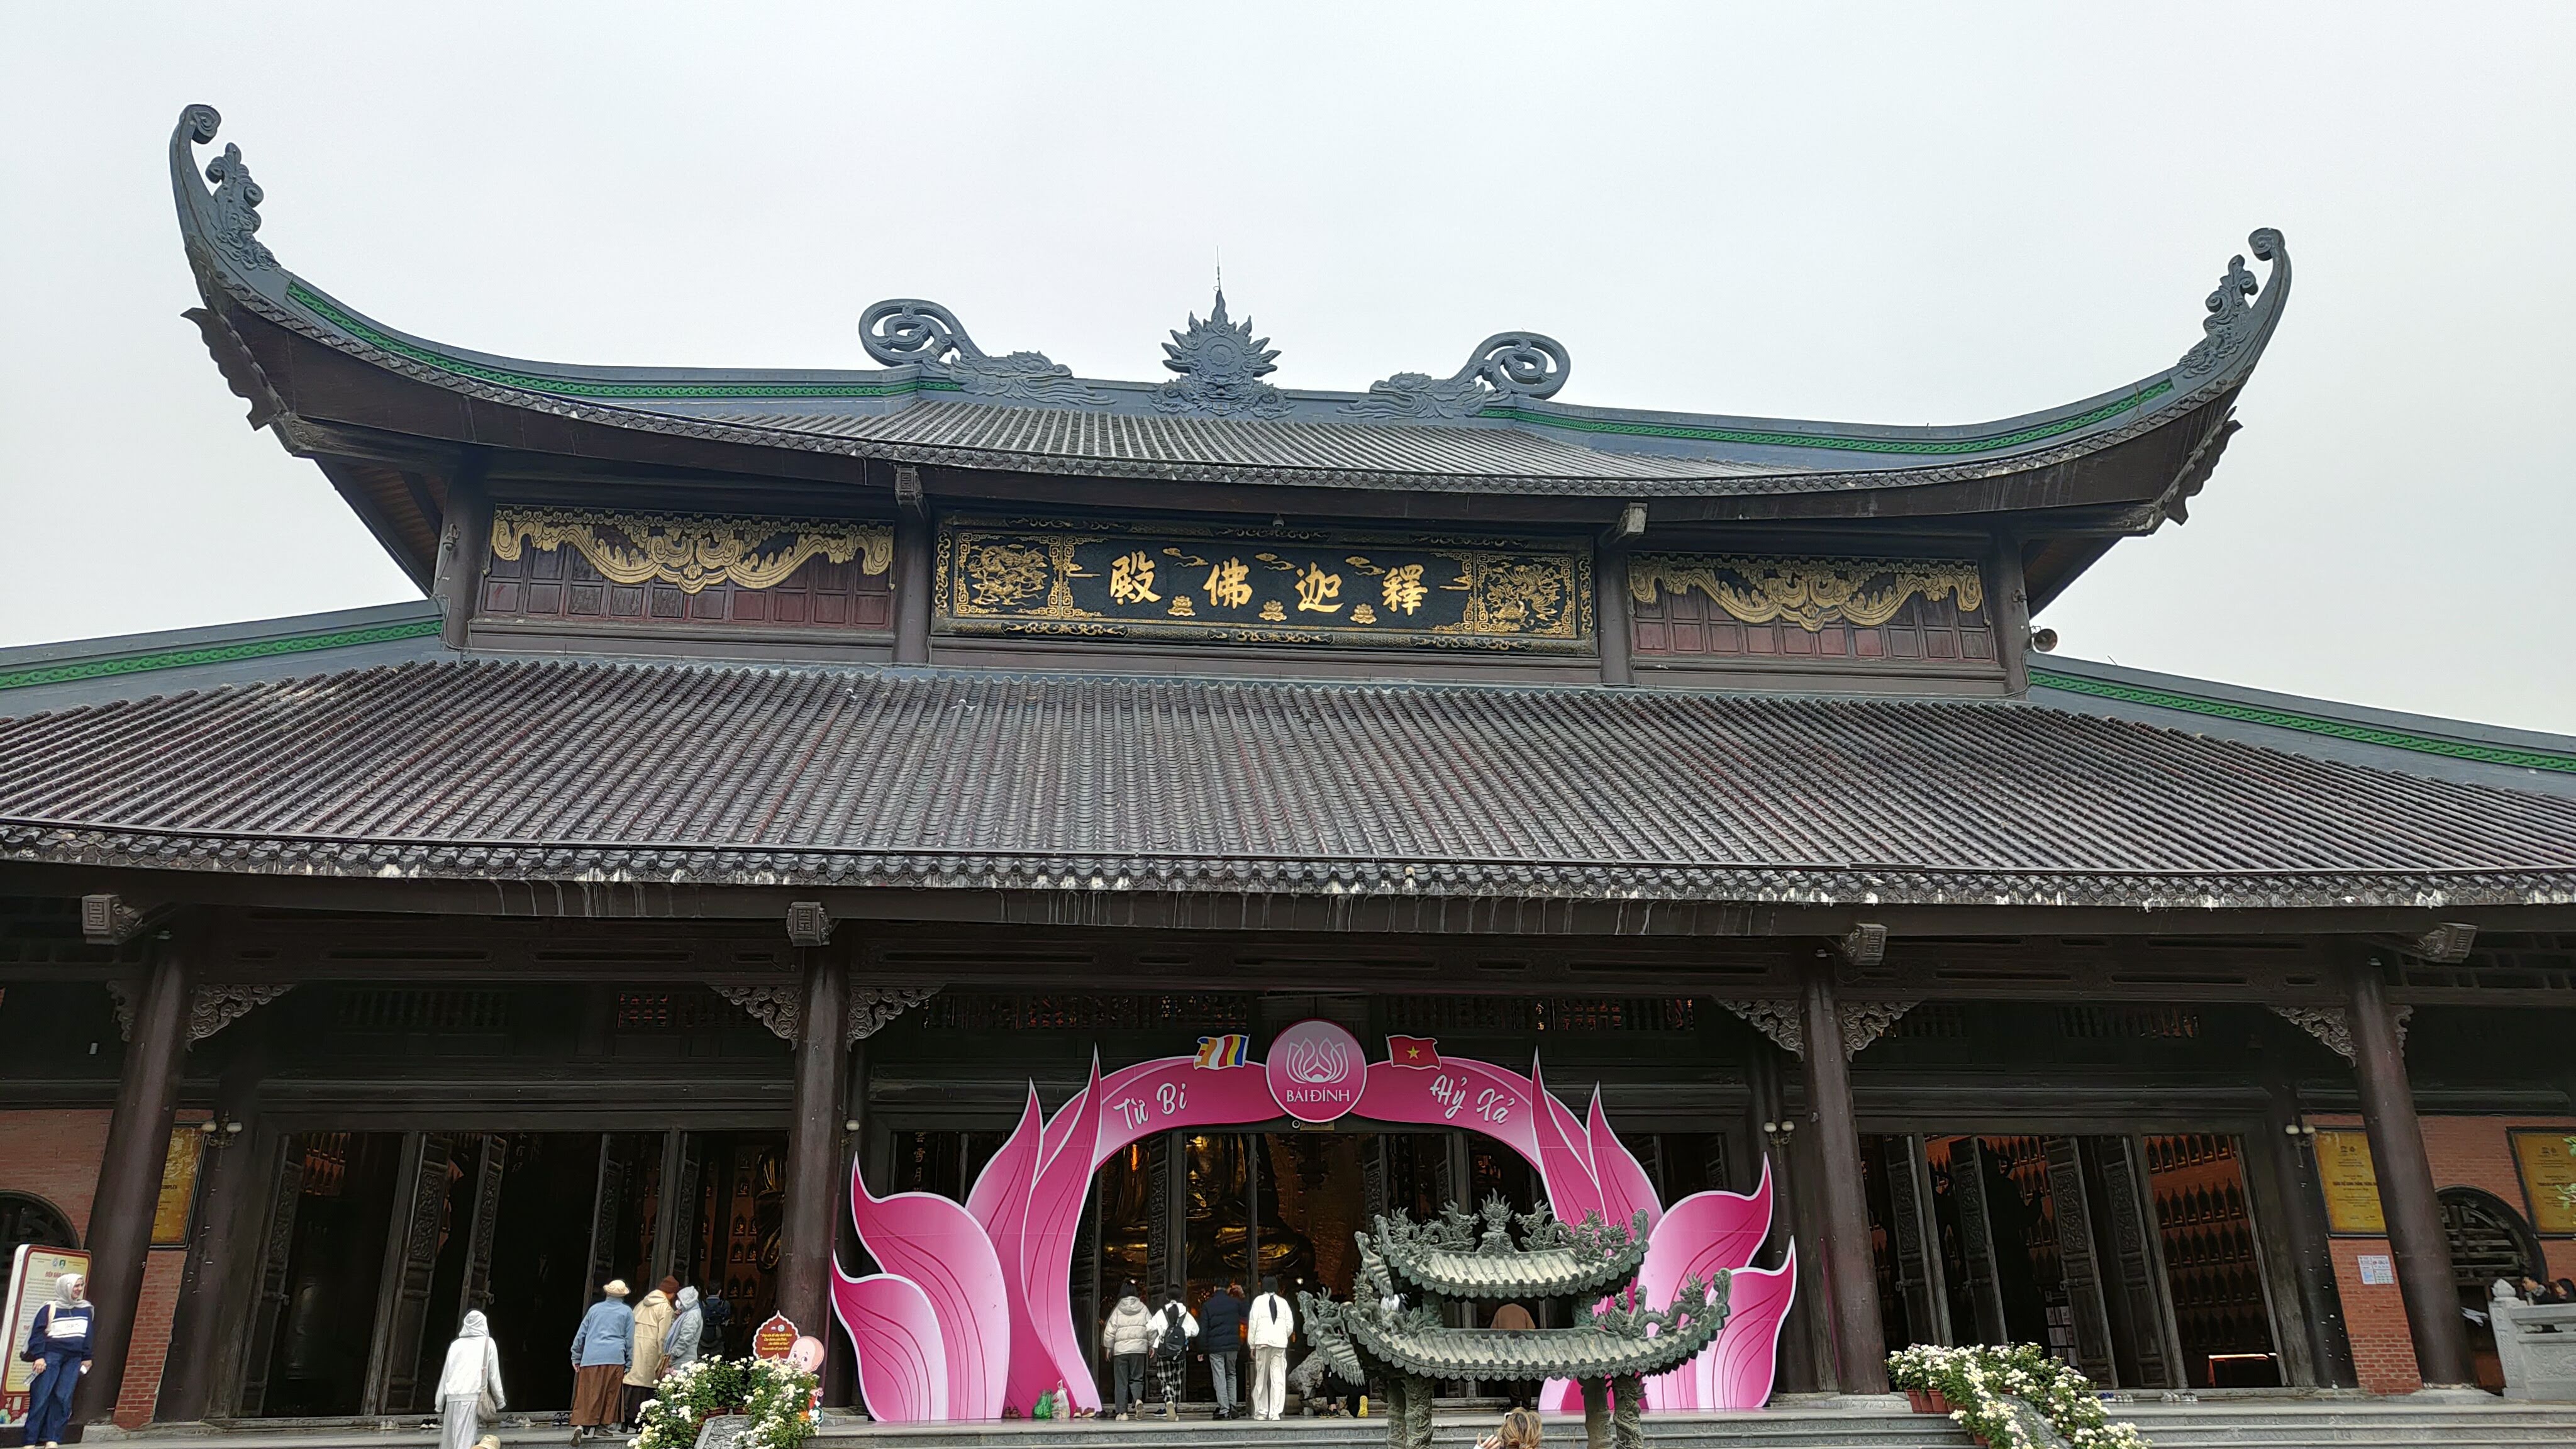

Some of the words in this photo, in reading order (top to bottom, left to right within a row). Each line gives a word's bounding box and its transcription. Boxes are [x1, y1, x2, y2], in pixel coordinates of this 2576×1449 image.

[1113, 1097, 1150, 1130] Từ
[1156, 1082, 1187, 1115] Bi
[1476, 1088, 1516, 1124] Xả
